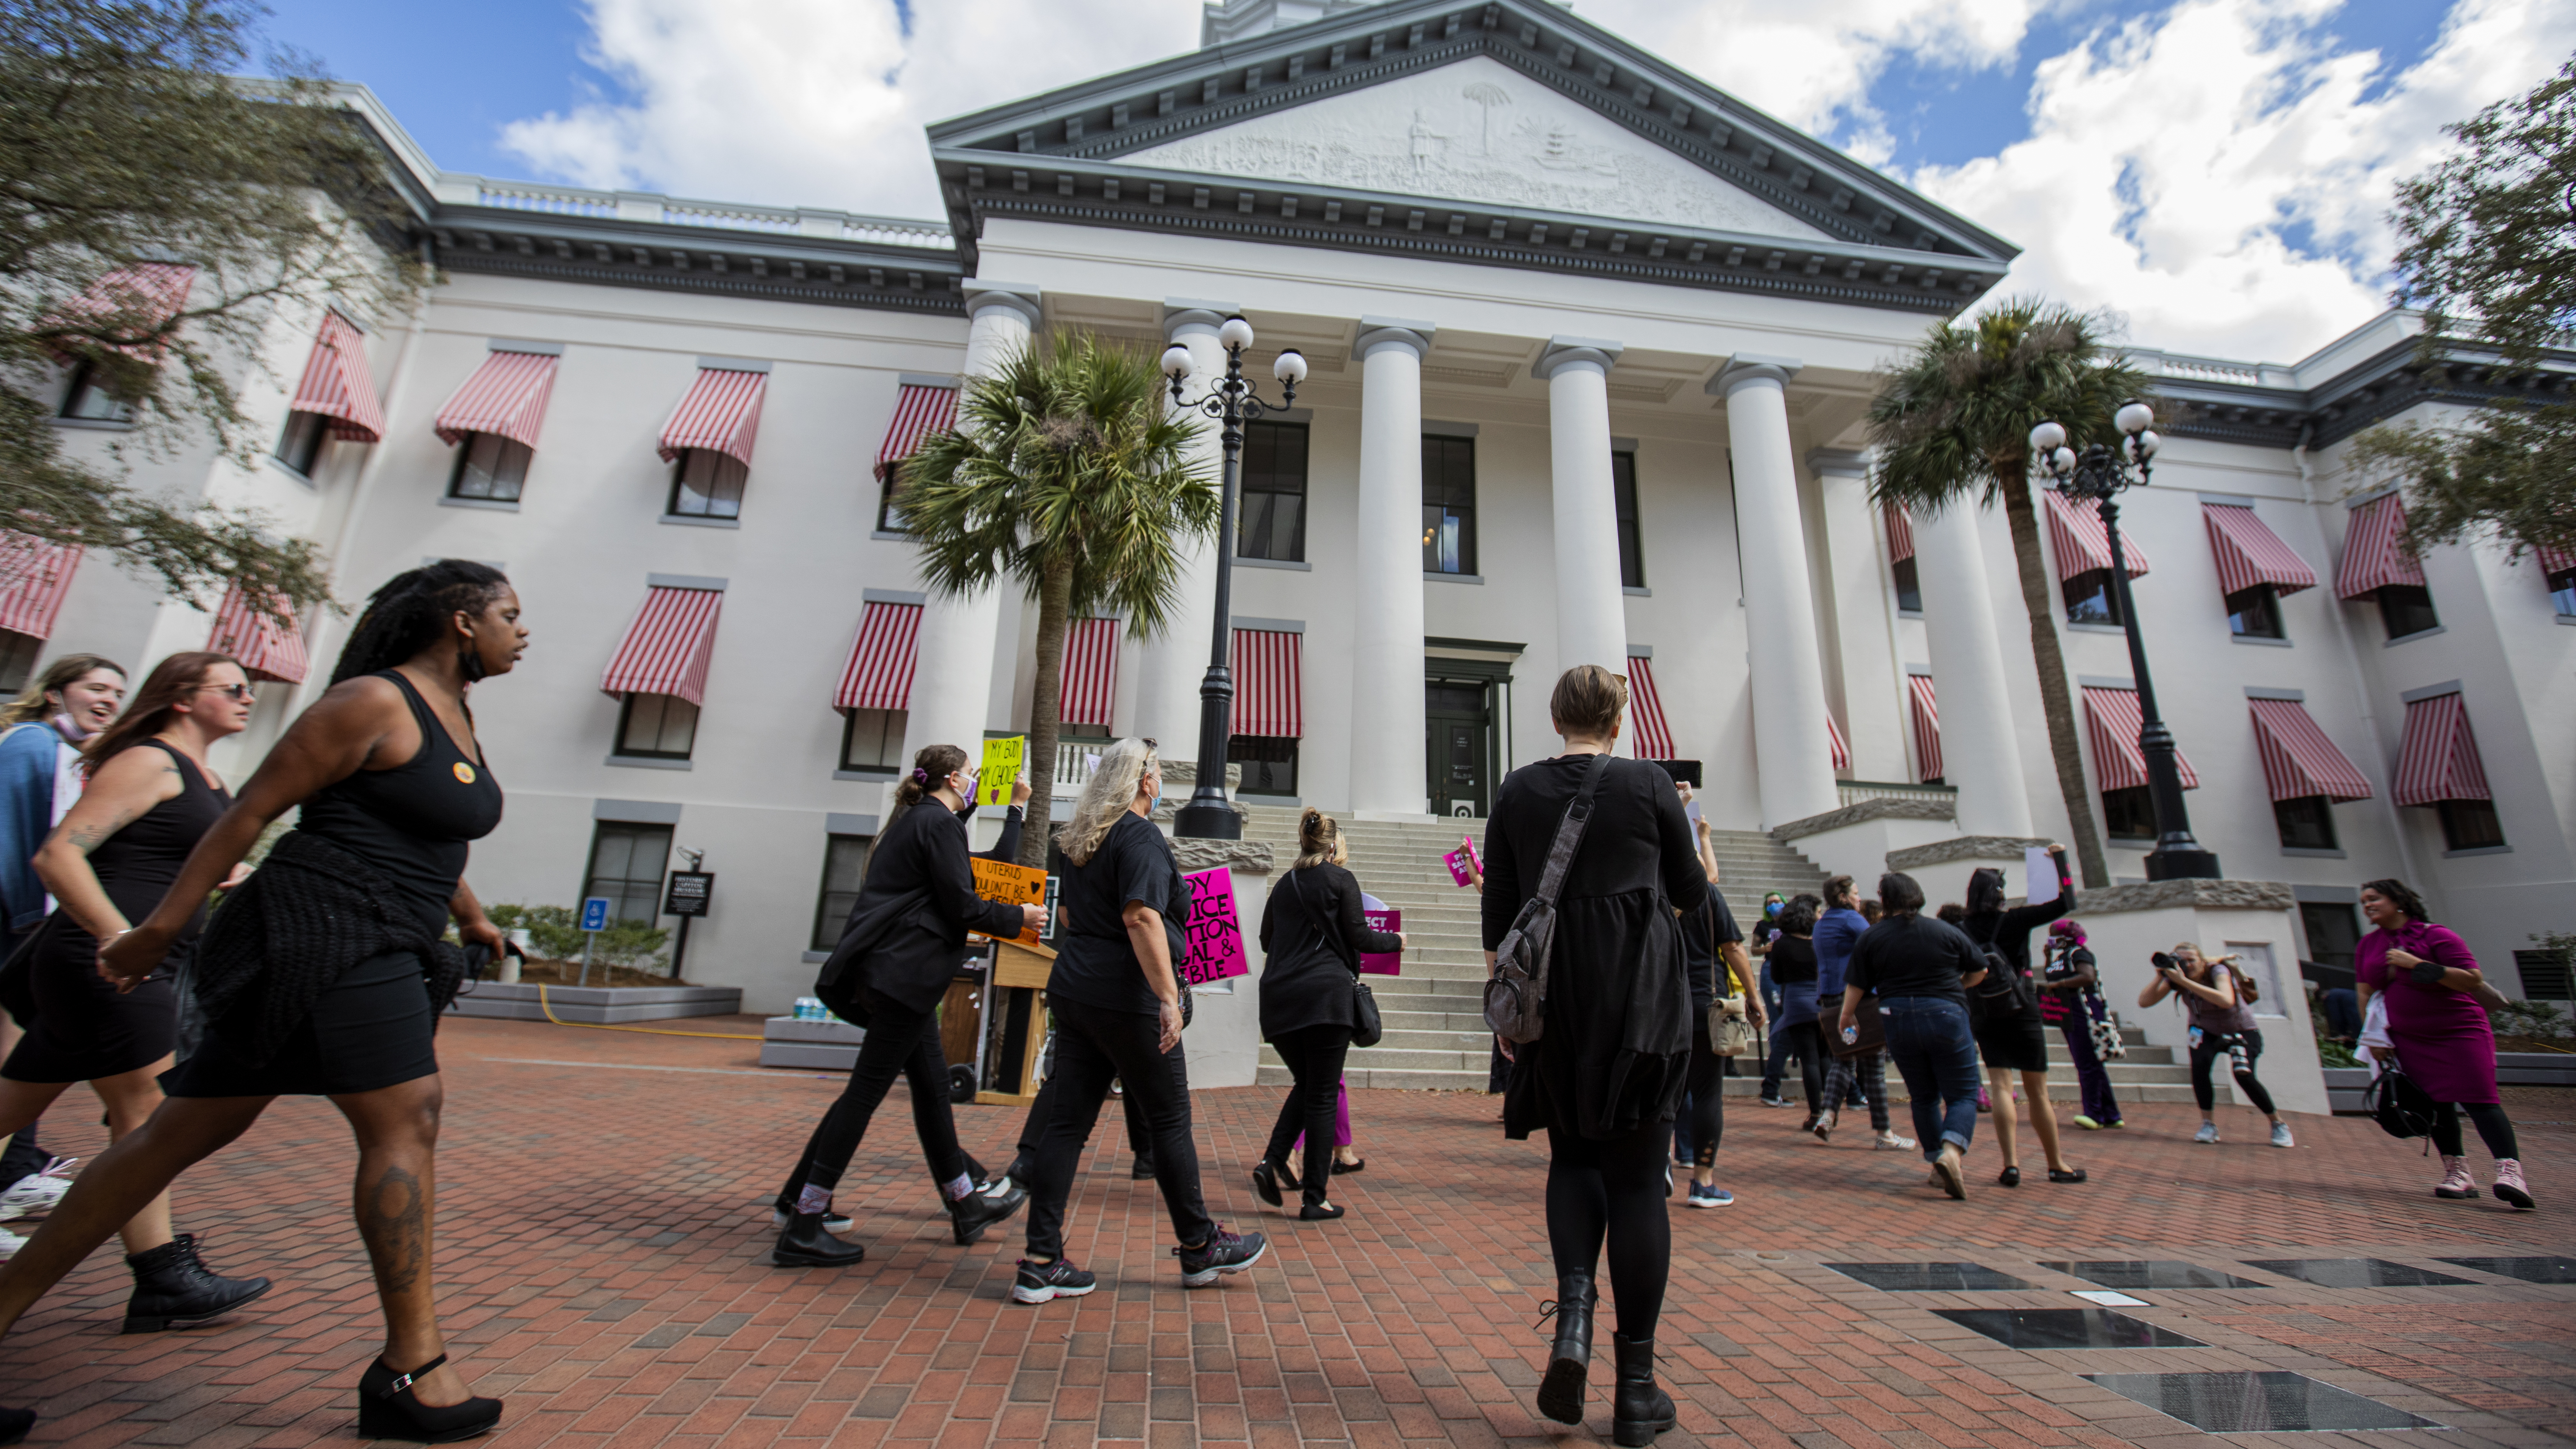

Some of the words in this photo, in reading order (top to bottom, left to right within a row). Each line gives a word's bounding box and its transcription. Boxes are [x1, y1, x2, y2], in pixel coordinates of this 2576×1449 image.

[991, 741, 1002, 759] MY
[1004, 740, 1020, 759] BODY
[981, 766, 991, 786] MY
[987, 863, 1022, 880] UTERUS
[975, 876, 1011, 895] OULDN'T
[1013, 885, 1026, 900] BE
[1186, 893, 1230, 922] ICE
[1185, 915, 1239, 944] TION
[1221, 938, 1236, 957] &
